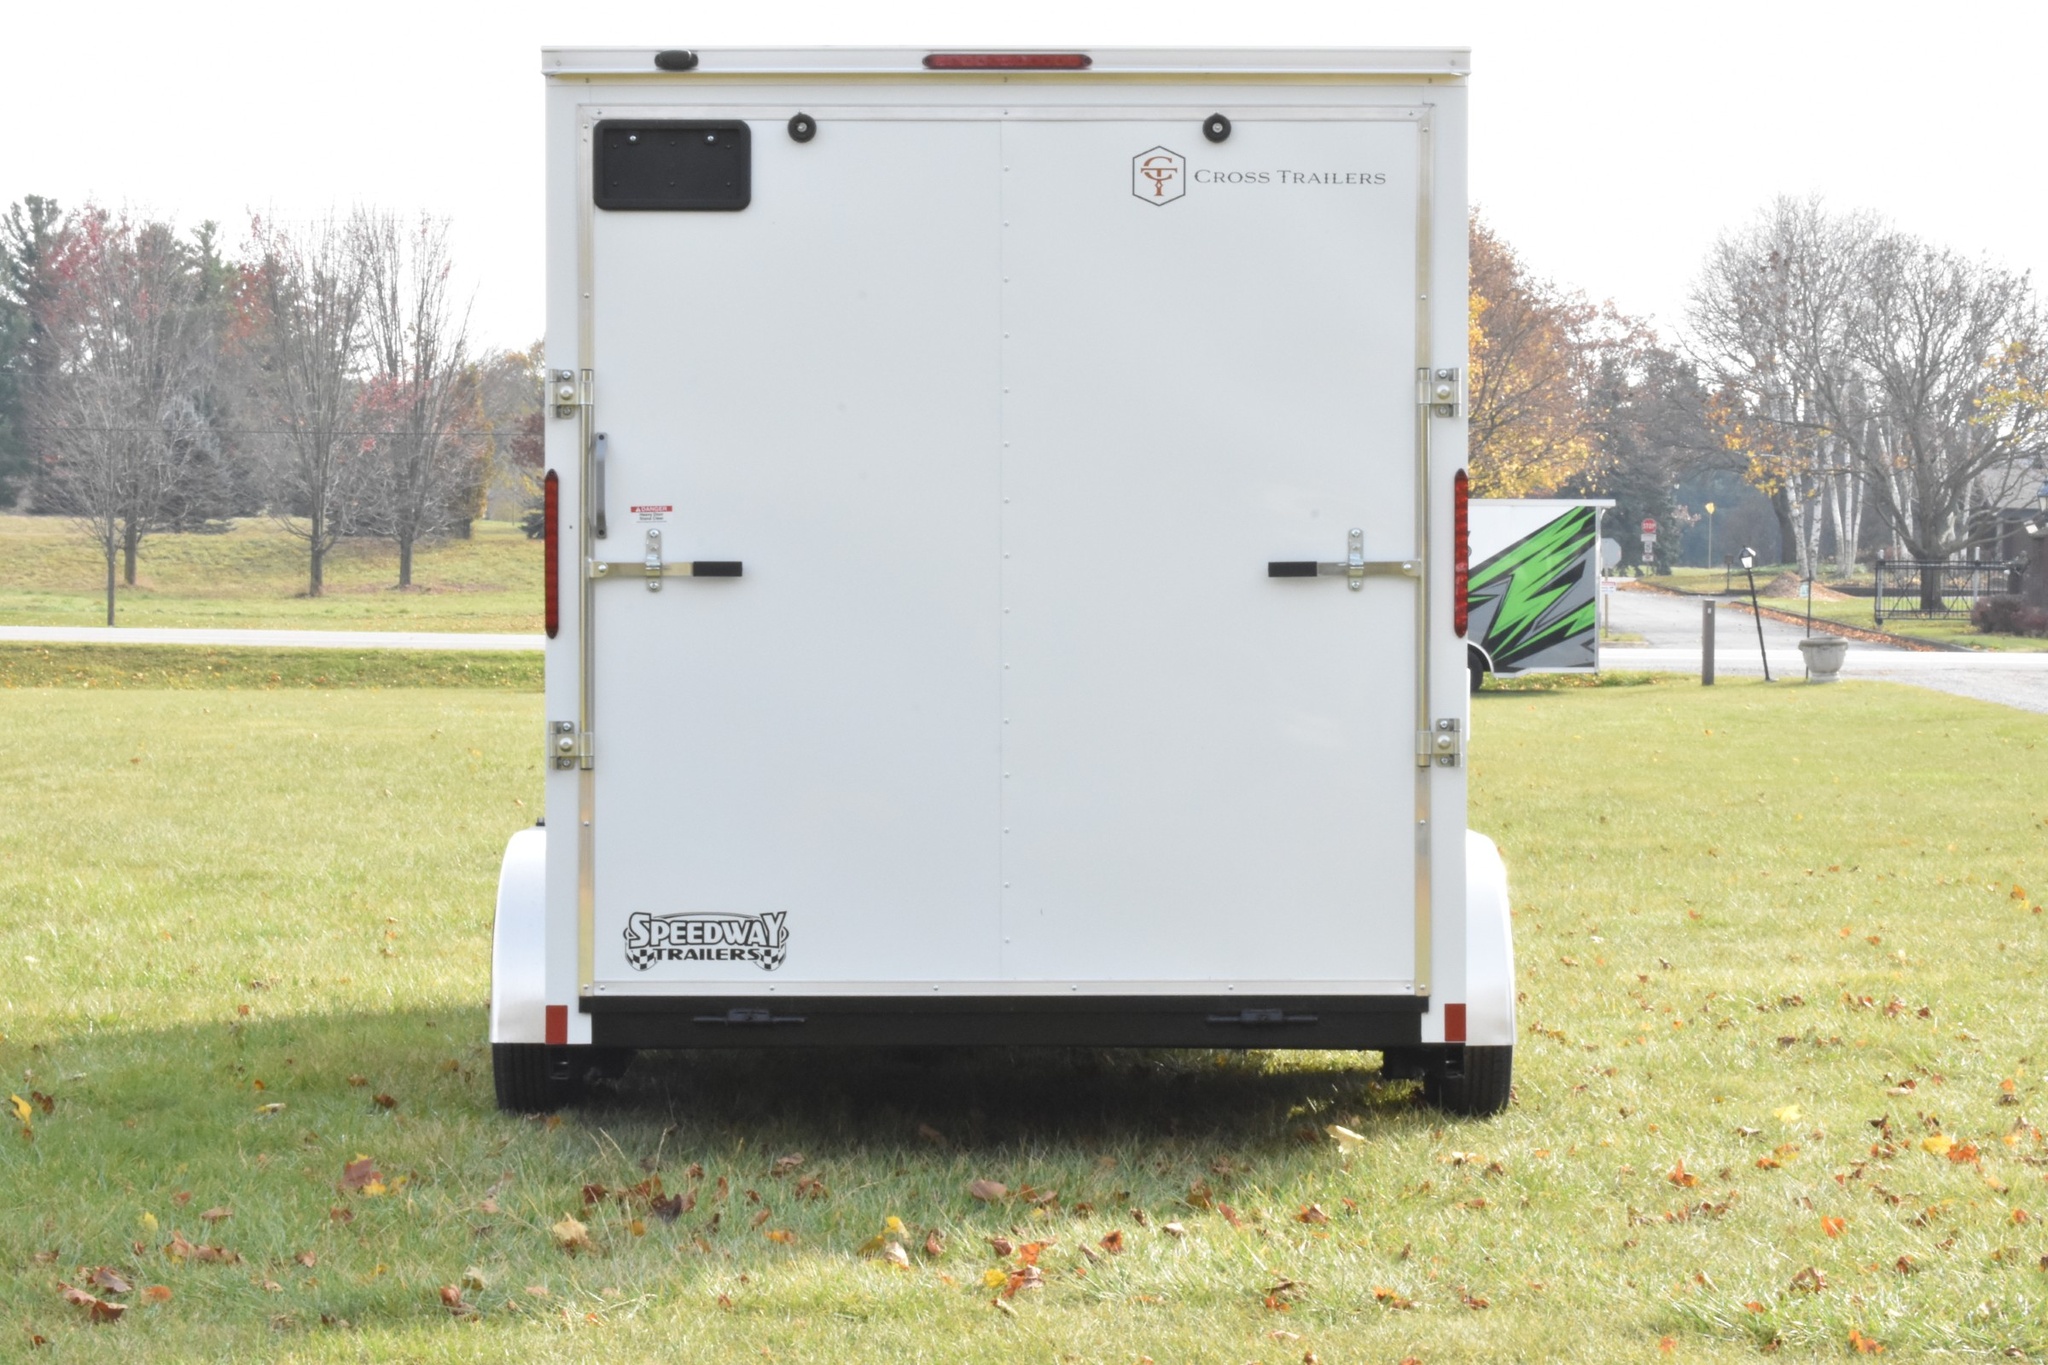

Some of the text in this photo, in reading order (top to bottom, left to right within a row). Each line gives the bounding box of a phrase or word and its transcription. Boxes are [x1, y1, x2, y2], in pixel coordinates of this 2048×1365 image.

[1276, 170, 1387, 185] TRAILERS
[628, 911, 787, 949] SPEEDWAY
[654, 948, 760, 961] TRAILERS
